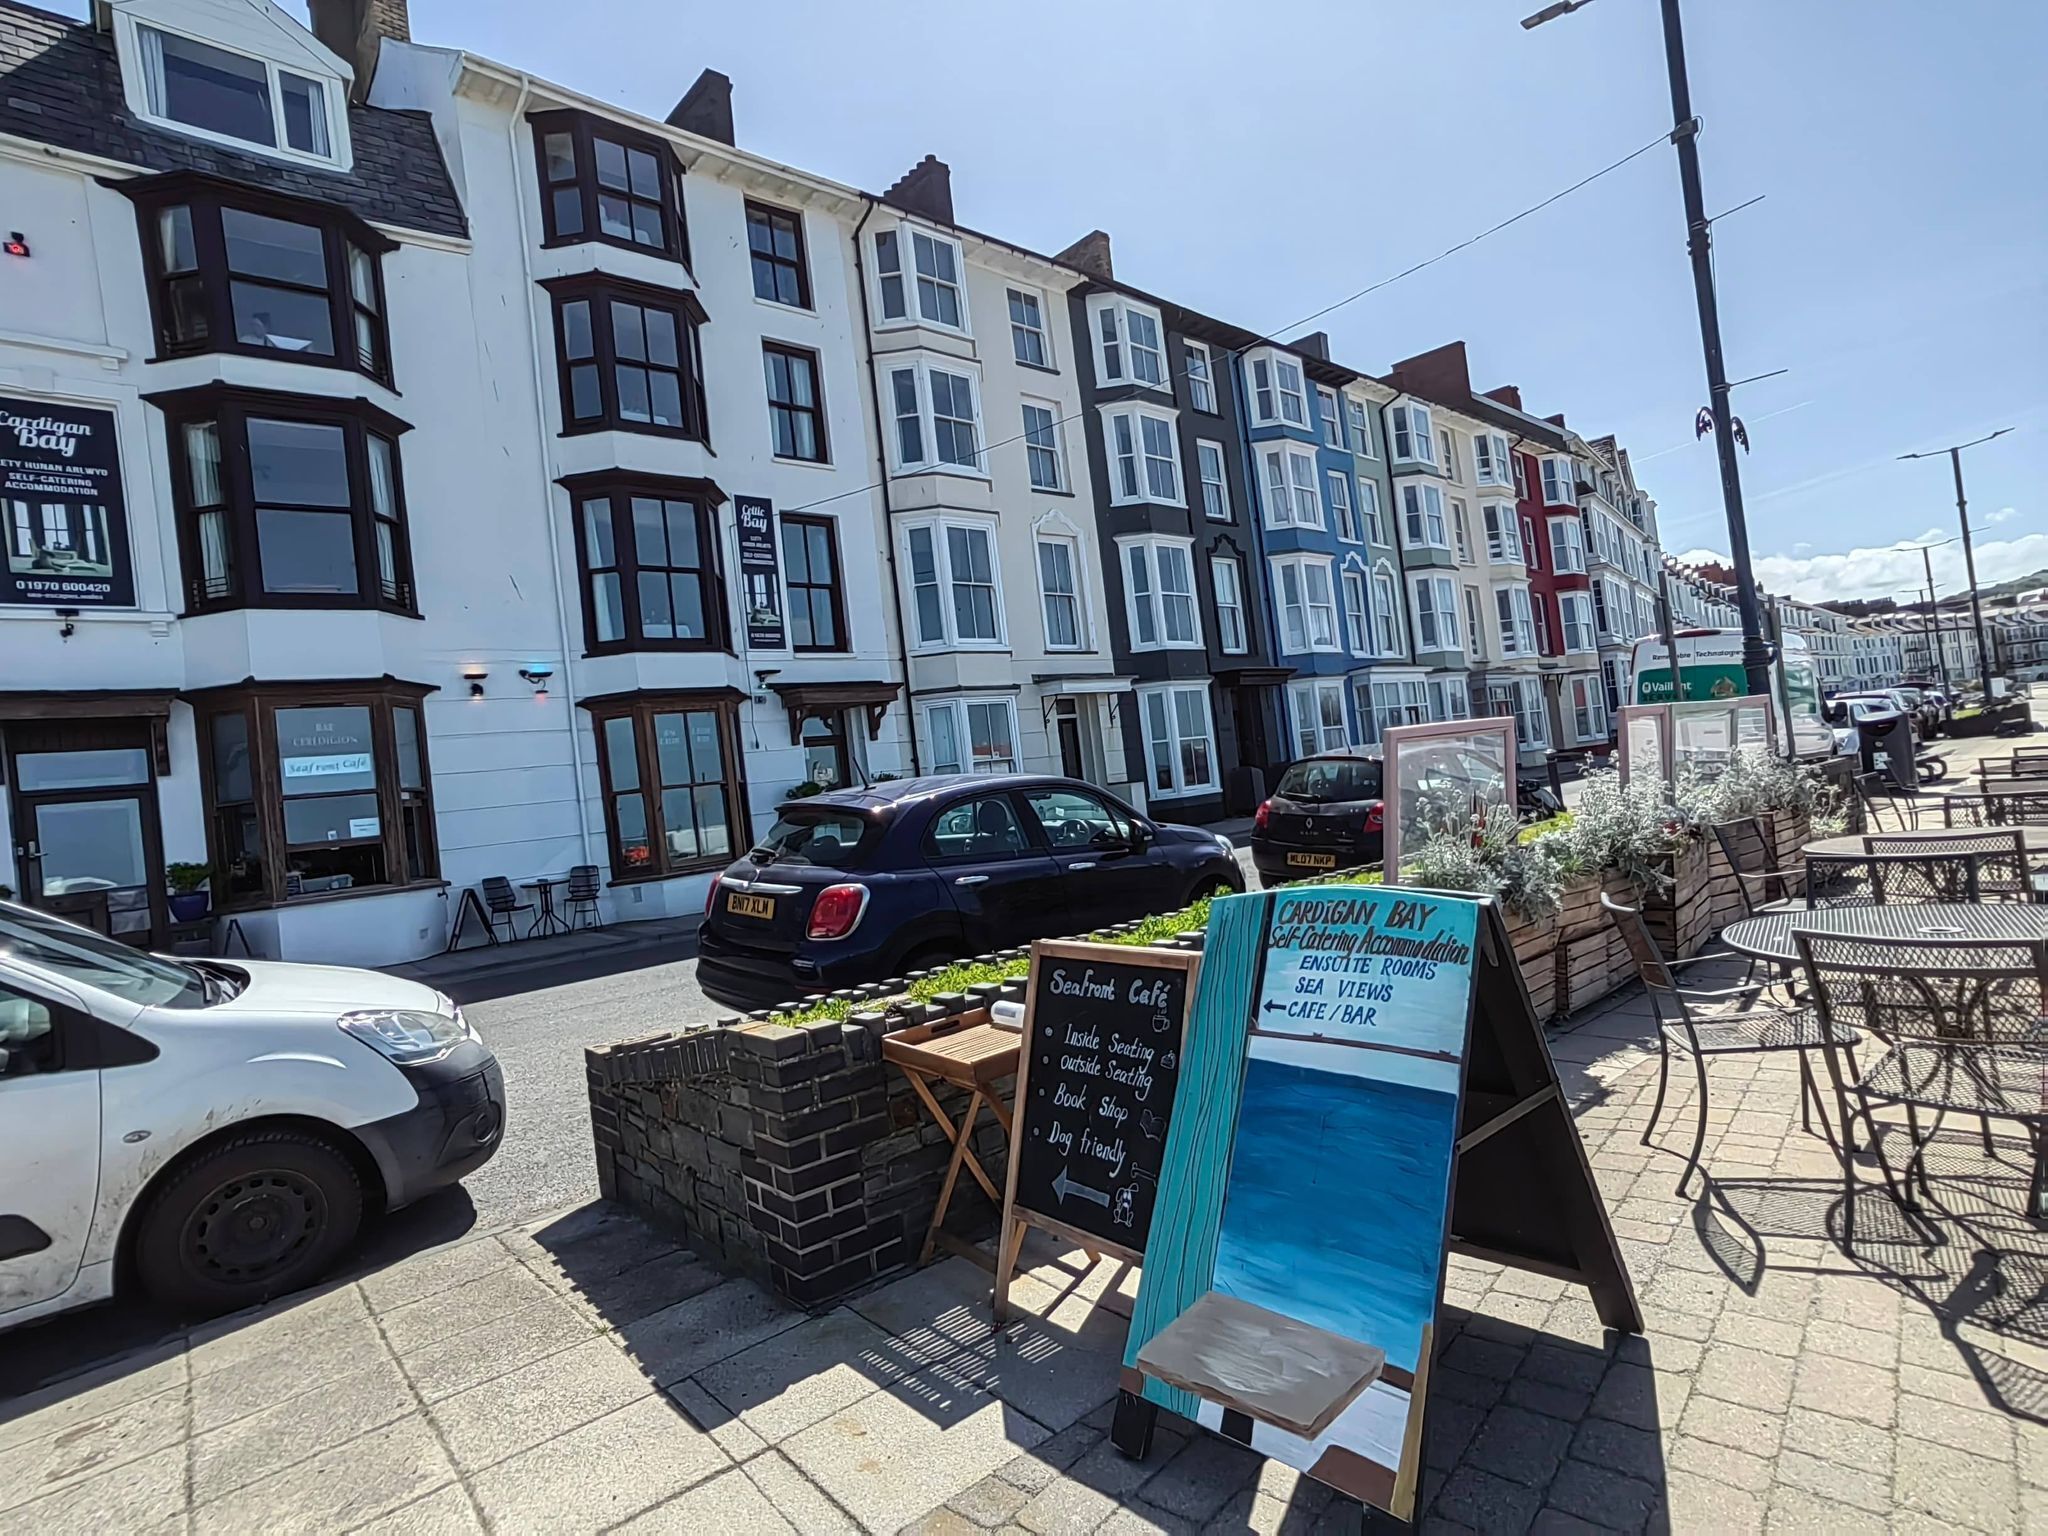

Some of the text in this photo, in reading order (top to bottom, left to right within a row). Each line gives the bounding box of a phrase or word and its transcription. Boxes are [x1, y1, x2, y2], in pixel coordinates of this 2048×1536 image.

[0, 410, 92, 436] Cardigan
[14, 425, 76, 457] Bay
[8, 472, 93, 487] SELF-CATERING
[24, 461, 62, 472] HUNAN
[65, 466, 108, 476] ARLWYO
[4, 481, 98, 496] ACCOMMODATION
[741, 513, 767, 533] Bay
[742, 504, 765, 516] Celtic
[16, 580, 110, 592] 01970 600420
[1652, 682, 1692, 692] Vaillnt
[732, 895, 750, 912] BN17
[1278, 900, 1438, 931] CARDIGAN BAY
[1268, 926, 1360, 958] Self-Catering
[1299, 955, 1438, 980] ENSUITE ROOMS
[1129, 979, 1171, 1007] Café
[1295, 976, 1394, 1002] SEA VIEWS
[1064, 1023, 1155, 1074] Inside Seating
[1105, 1060, 1154, 1101] Seating
[1054, 1082, 1128, 1128] Book Shop
[1047, 1121, 1127, 1178] Dog friendly
